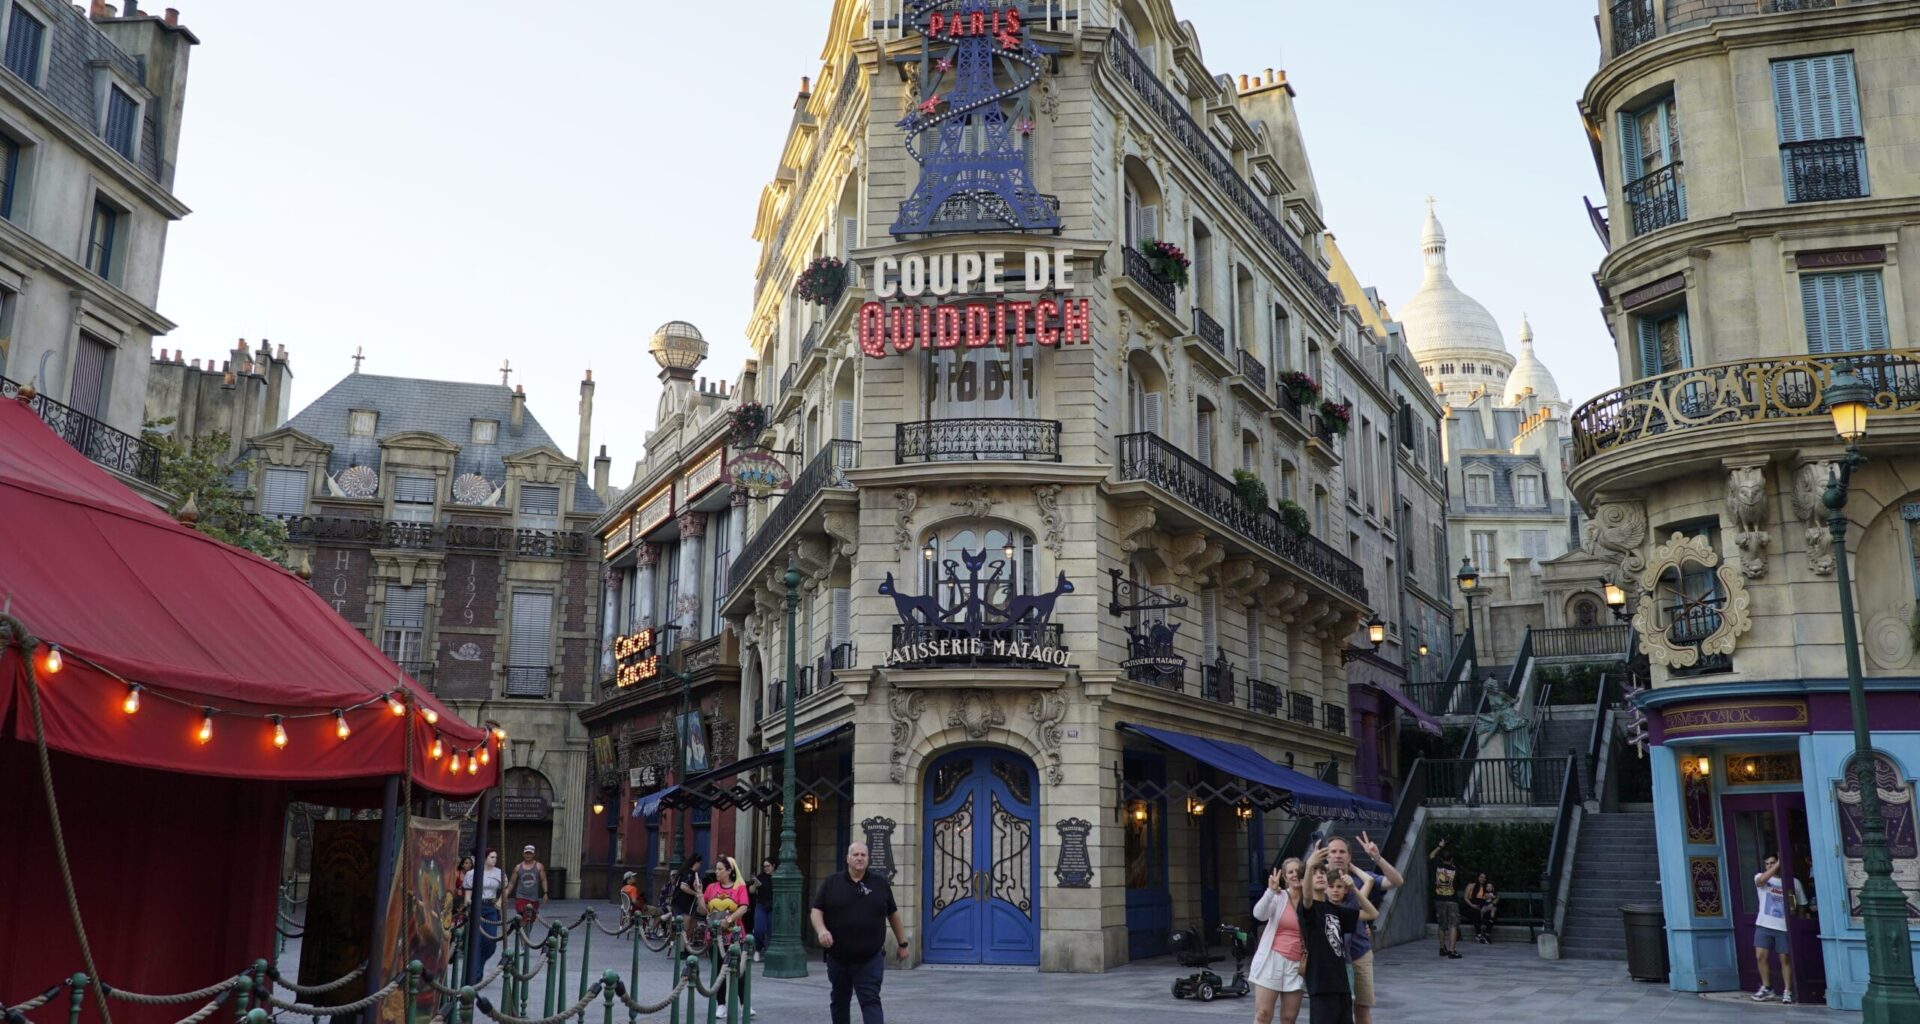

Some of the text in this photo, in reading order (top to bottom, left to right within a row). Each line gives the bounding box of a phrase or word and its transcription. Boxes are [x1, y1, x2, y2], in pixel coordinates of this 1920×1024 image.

[928, 7, 1021, 38] PARIS
[873, 248, 1075, 298] COUPE DE
[1817, 252, 1865, 265] ACACIA
[859, 298, 1090, 359] QUIDDITCH
[463, 559, 476, 625] 1879
[882, 637, 1073, 667] PATISSERIE MATAGOT
[1122, 657, 1184, 668] PATISSERIE MATAGOT
